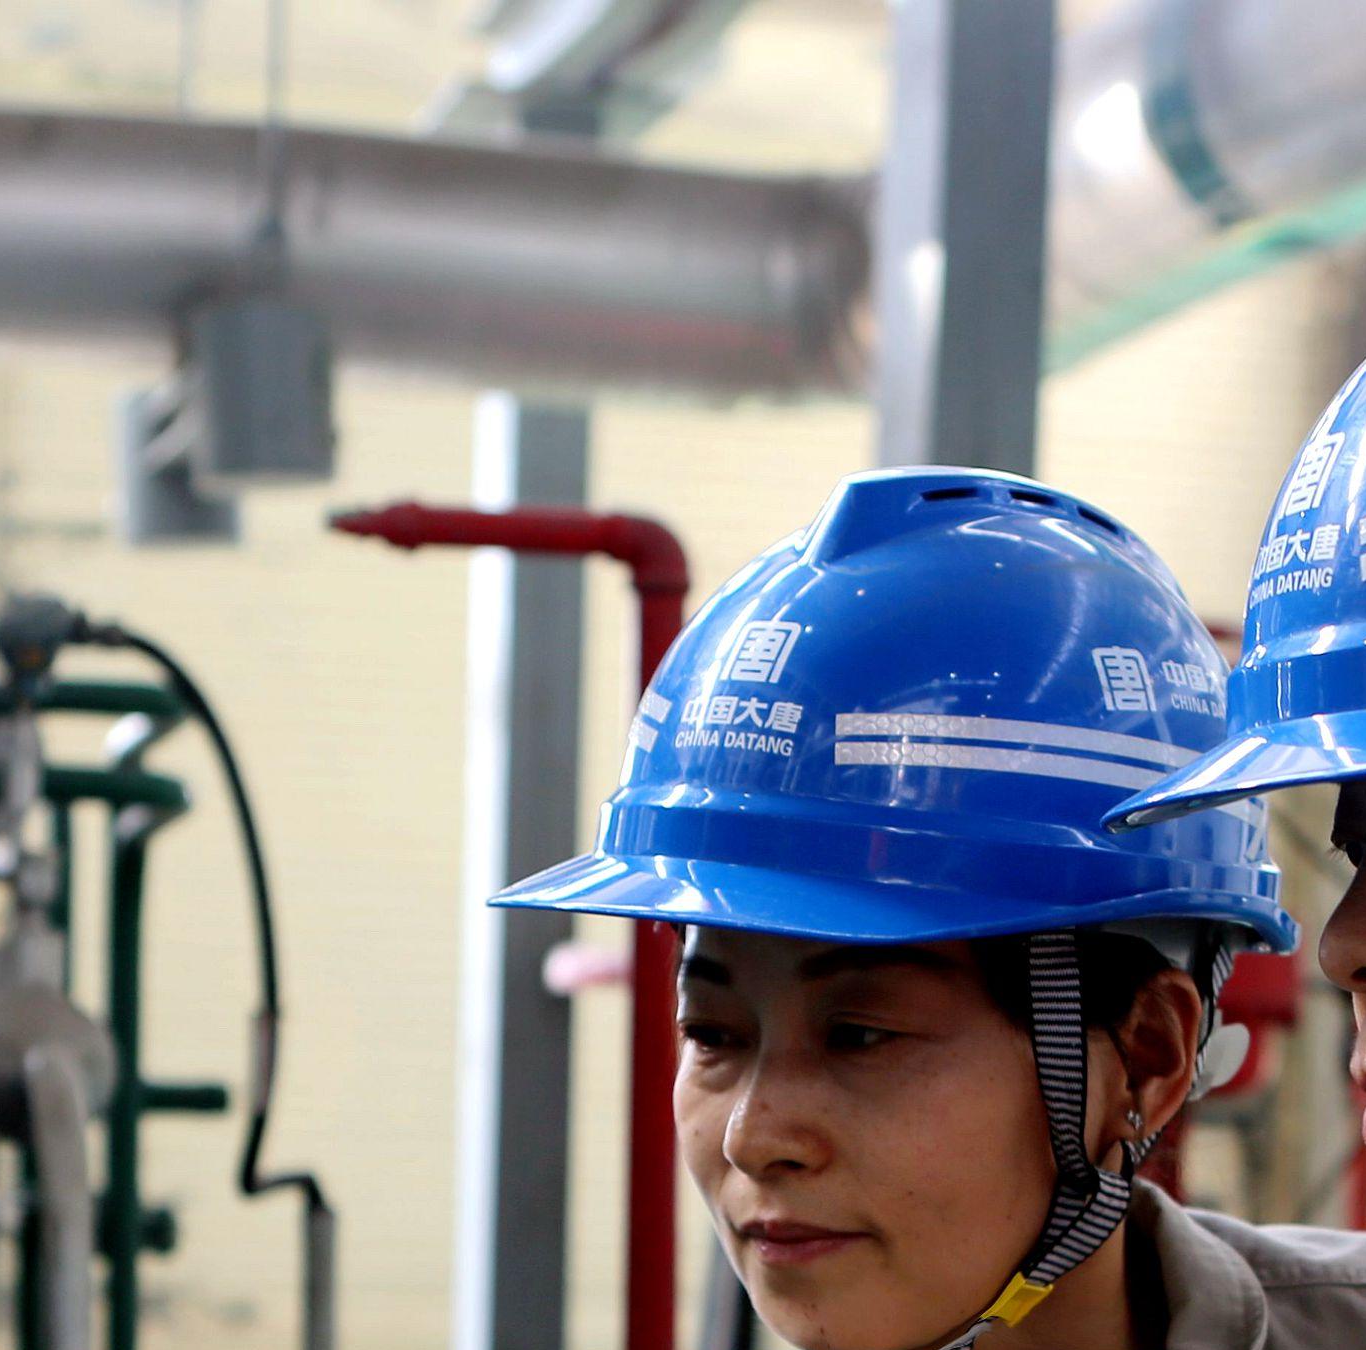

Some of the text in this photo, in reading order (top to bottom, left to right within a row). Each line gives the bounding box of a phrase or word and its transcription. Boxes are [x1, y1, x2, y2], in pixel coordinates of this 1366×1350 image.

[1254, 524, 1340, 580] 中国大唐
[1276, 567, 1333, 596] DATANG
[680, 695, 803, 734] 中国大唐
[1171, 693, 1209, 715] CHINA
[675, 729, 794, 756] CHINA DATANG
